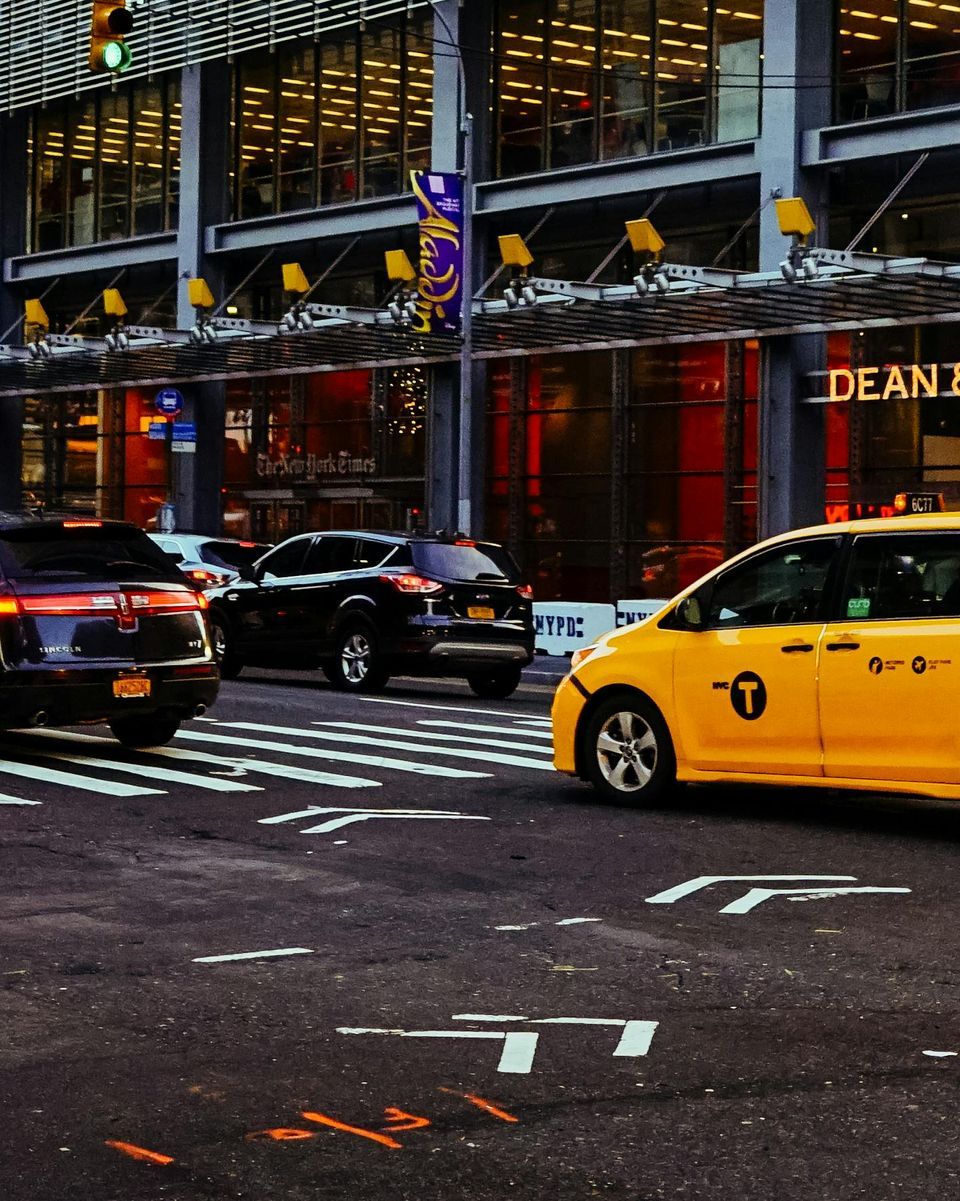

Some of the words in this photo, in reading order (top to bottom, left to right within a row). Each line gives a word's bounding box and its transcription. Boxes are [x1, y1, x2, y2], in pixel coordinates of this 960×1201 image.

[829, 363, 938, 401] DEAN
[911, 497, 933, 512] 6C77
[535, 614, 575, 637] NYPD
